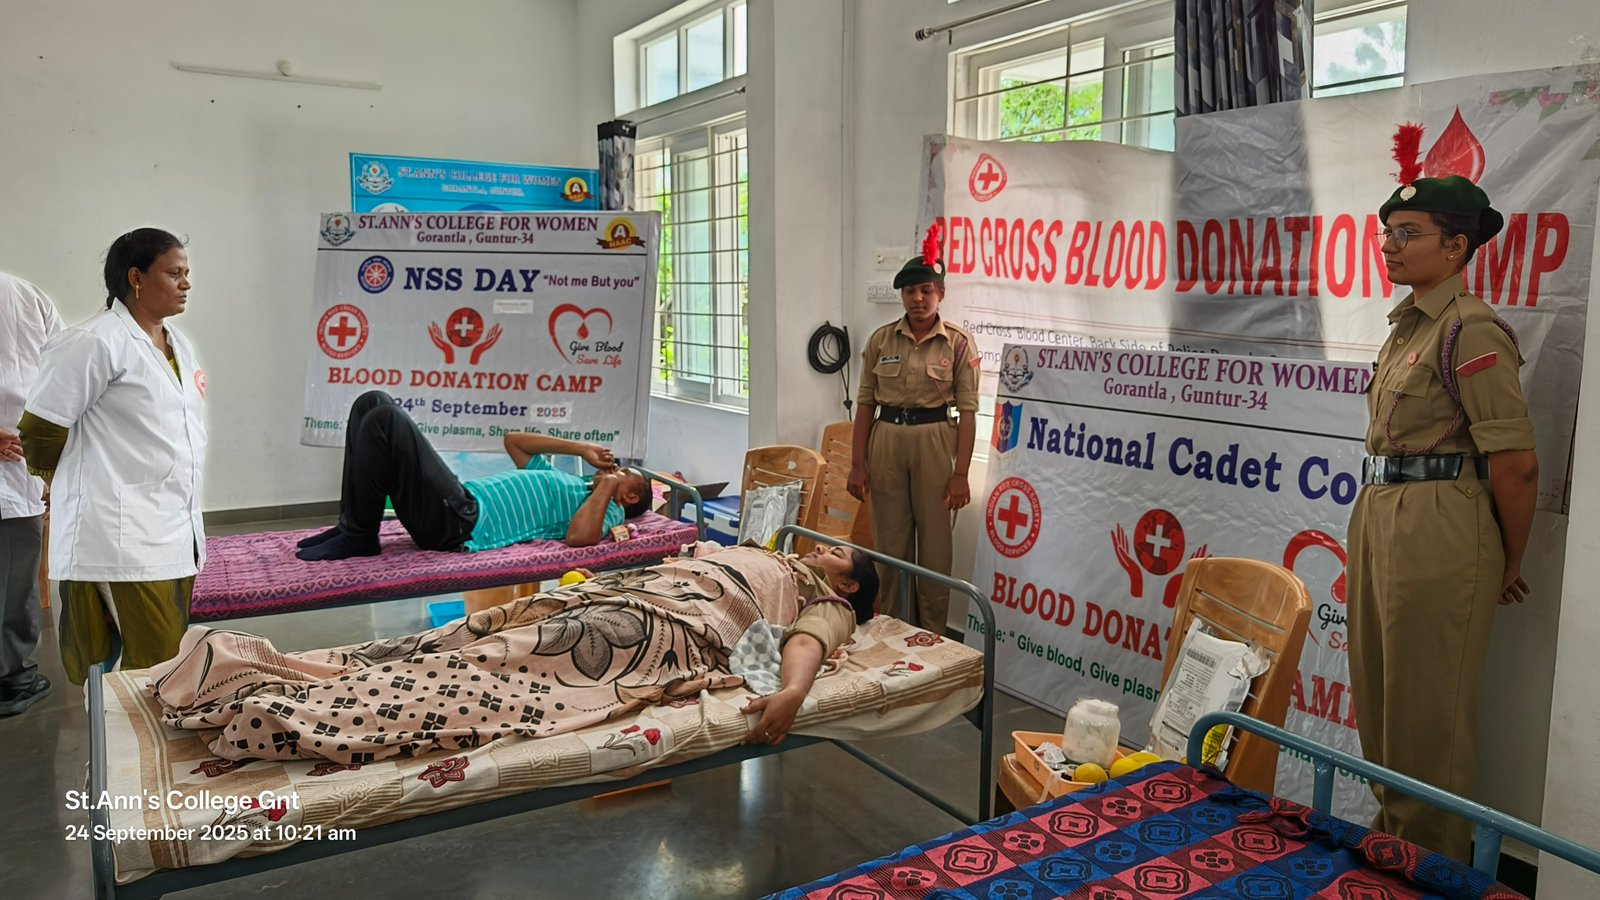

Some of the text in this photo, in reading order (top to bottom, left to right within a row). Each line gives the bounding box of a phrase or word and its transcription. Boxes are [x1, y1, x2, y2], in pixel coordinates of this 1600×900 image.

[358, 215, 598, 231] ST.ANN'S COLLEGE FOR WOMEN
[417, 231, 466, 243] Gorantla
[476, 232, 534, 244] Guntur-34
[980, 217, 1063, 284] CROSS
[1064, 220, 1166, 290] BLOOD
[1175, 213, 1394, 298] DONATION
[1461, 212, 1570, 307] MP
[404, 267, 463, 291] NSS
[474, 268, 540, 292] DAY
[571, 277, 588, 287] me
[592, 275, 610, 287] But
[962, 320, 983, 334] Red
[986, 322, 1012, 338] Cross
[1017, 327, 1045, 342] Blood
[569, 341, 624, 356] Give Blood
[577, 354, 621, 368] Save Life
[1037, 349, 1112, 373] ST.ANN'S
[1117, 352, 1209, 381] COLLEGE
[1215, 358, 1263, 386] FOR
[328, 367, 603, 394] BLOOD DONATION CAMP
[1104, 378, 1167, 400] Gorantla
[1181, 384, 1268, 410] Guntur-34
[431, 399, 528, 417] September
[536, 407, 567, 418] 2025
[304, 417, 343, 430] Theme:
[442, 423, 485, 438] plasma,
[548, 427, 581, 440] Share
[1027, 416, 1357, 505] National Cadet Co
[1317, 603, 1347, 630] Giv
[968, 614, 1005, 643] Thee:
[1017, 634, 1043, 657] Give
[1046, 644, 1085, 677] blood,
[1090, 661, 1120, 687] Give
[990, 571, 1075, 627] BLOOD
[1289, 670, 1358, 729] AM
[1328, 630, 1348, 652] Sa
